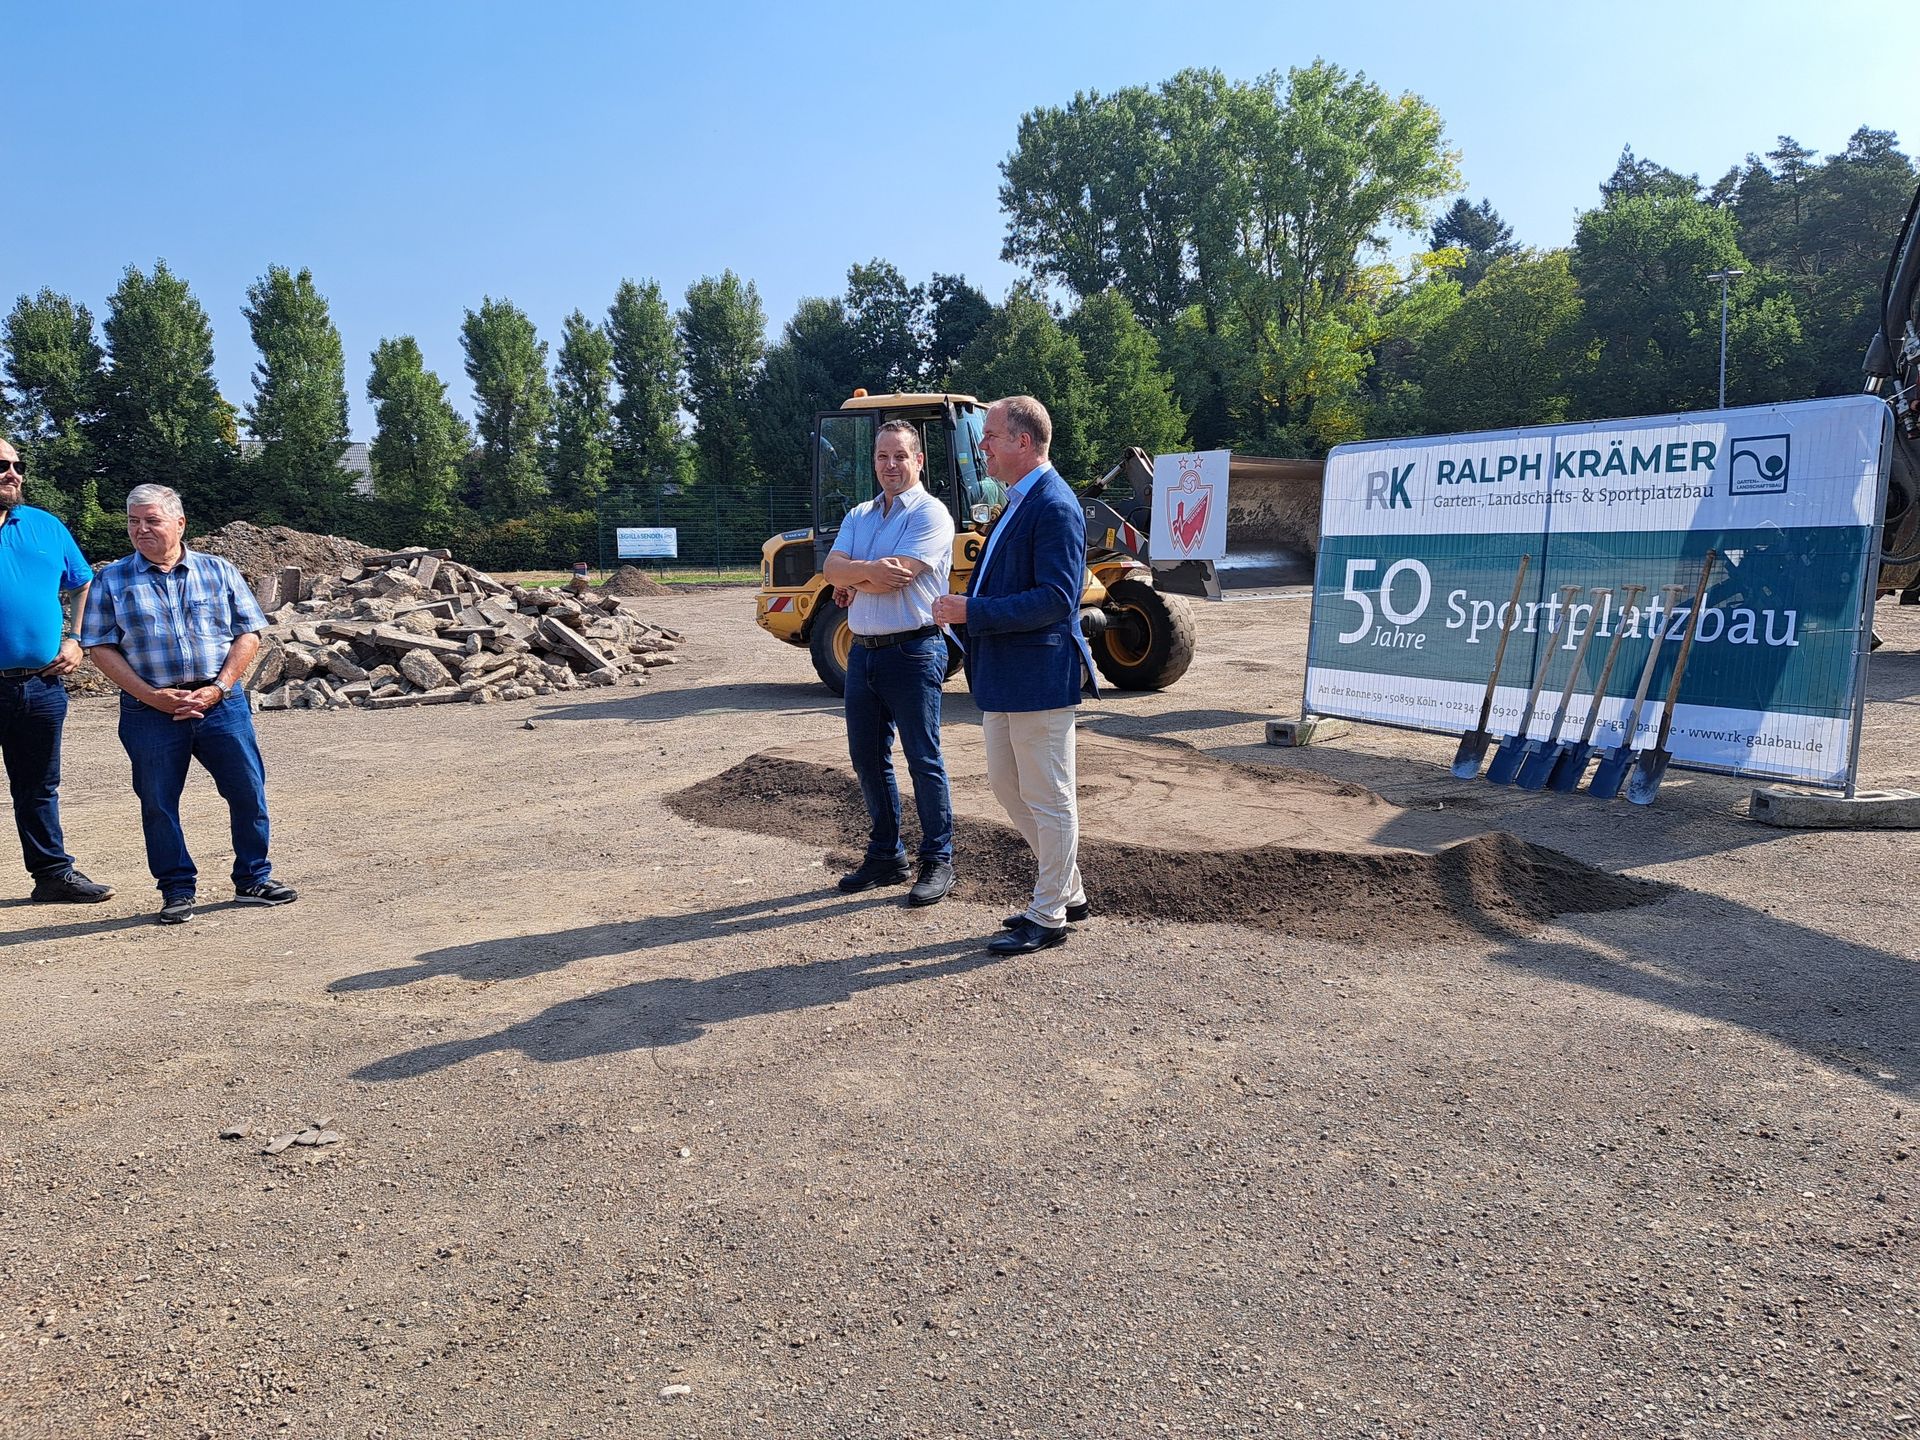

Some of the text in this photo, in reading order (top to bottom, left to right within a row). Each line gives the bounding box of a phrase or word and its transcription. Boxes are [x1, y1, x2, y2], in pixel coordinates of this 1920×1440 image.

[1366, 462, 1416, 510] RK
[1437, 440, 1717, 485] RALPH KRÄMER
[1434, 484, 1714, 508] Garten-, Landschafts- & Sportplatzbau
[1338, 558, 1432, 644] 50
[1446, 589, 1800, 650] Sportplatzbau
[1371, 625, 1427, 650] Jahre
[1318, 684, 1330, 695] An
[1331, 686, 1345, 696] der
[1345, 687, 1371, 699] Ronne
[1373, 692, 1383, 702] 59
[1389, 694, 1415, 706] 50859
[1417, 695, 1437, 707] Köln
[1689, 728, 1823, 753] www.rk-galabau.de
